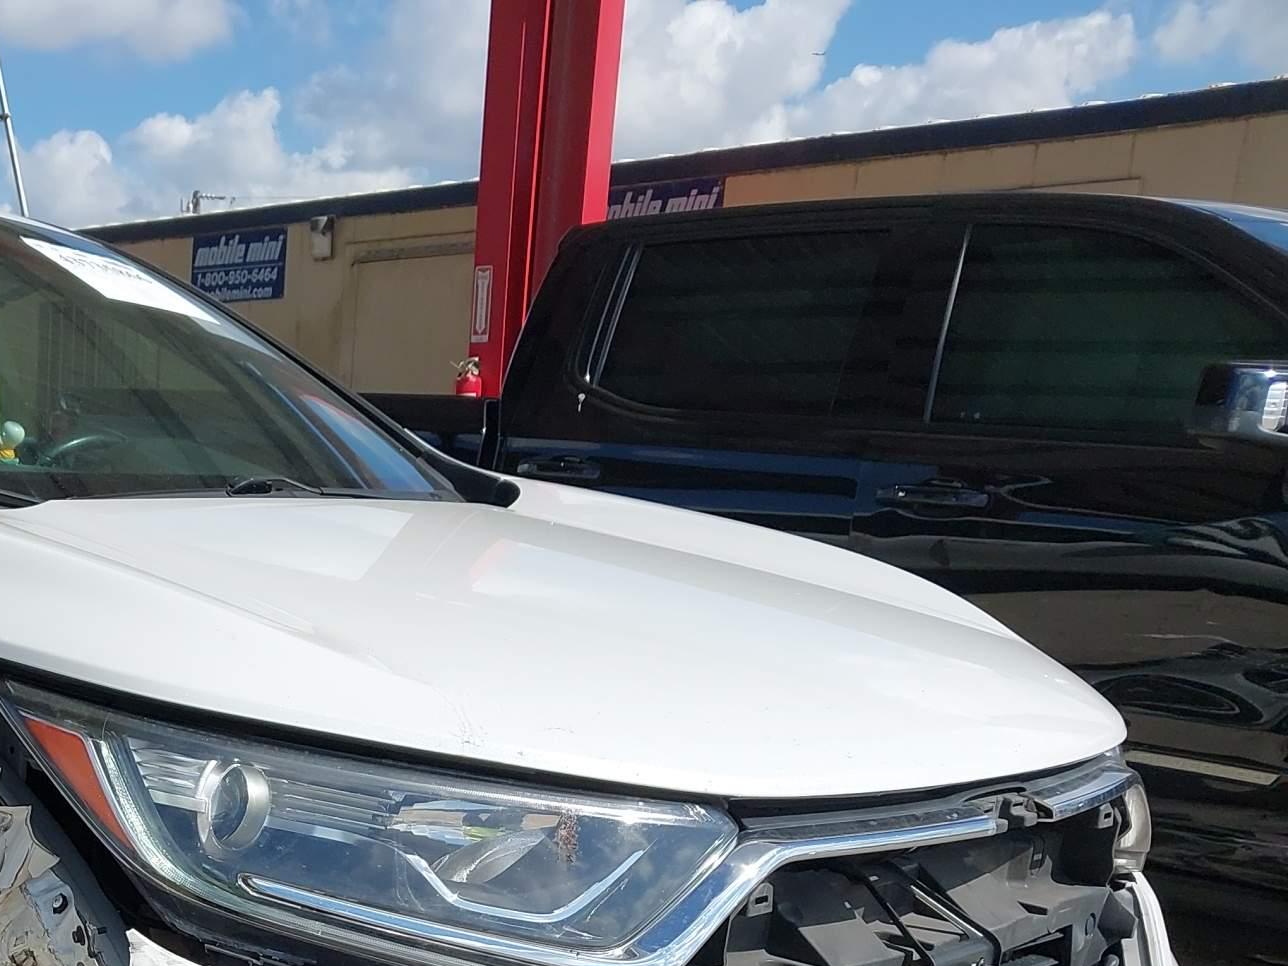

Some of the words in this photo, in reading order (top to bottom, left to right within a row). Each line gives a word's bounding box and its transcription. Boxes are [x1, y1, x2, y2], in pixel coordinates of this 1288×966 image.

[607, 188, 663, 220] obile
[665, 186, 720, 213] mini
[194, 234, 246, 267] mobile
[246, 234, 285, 263] mini
